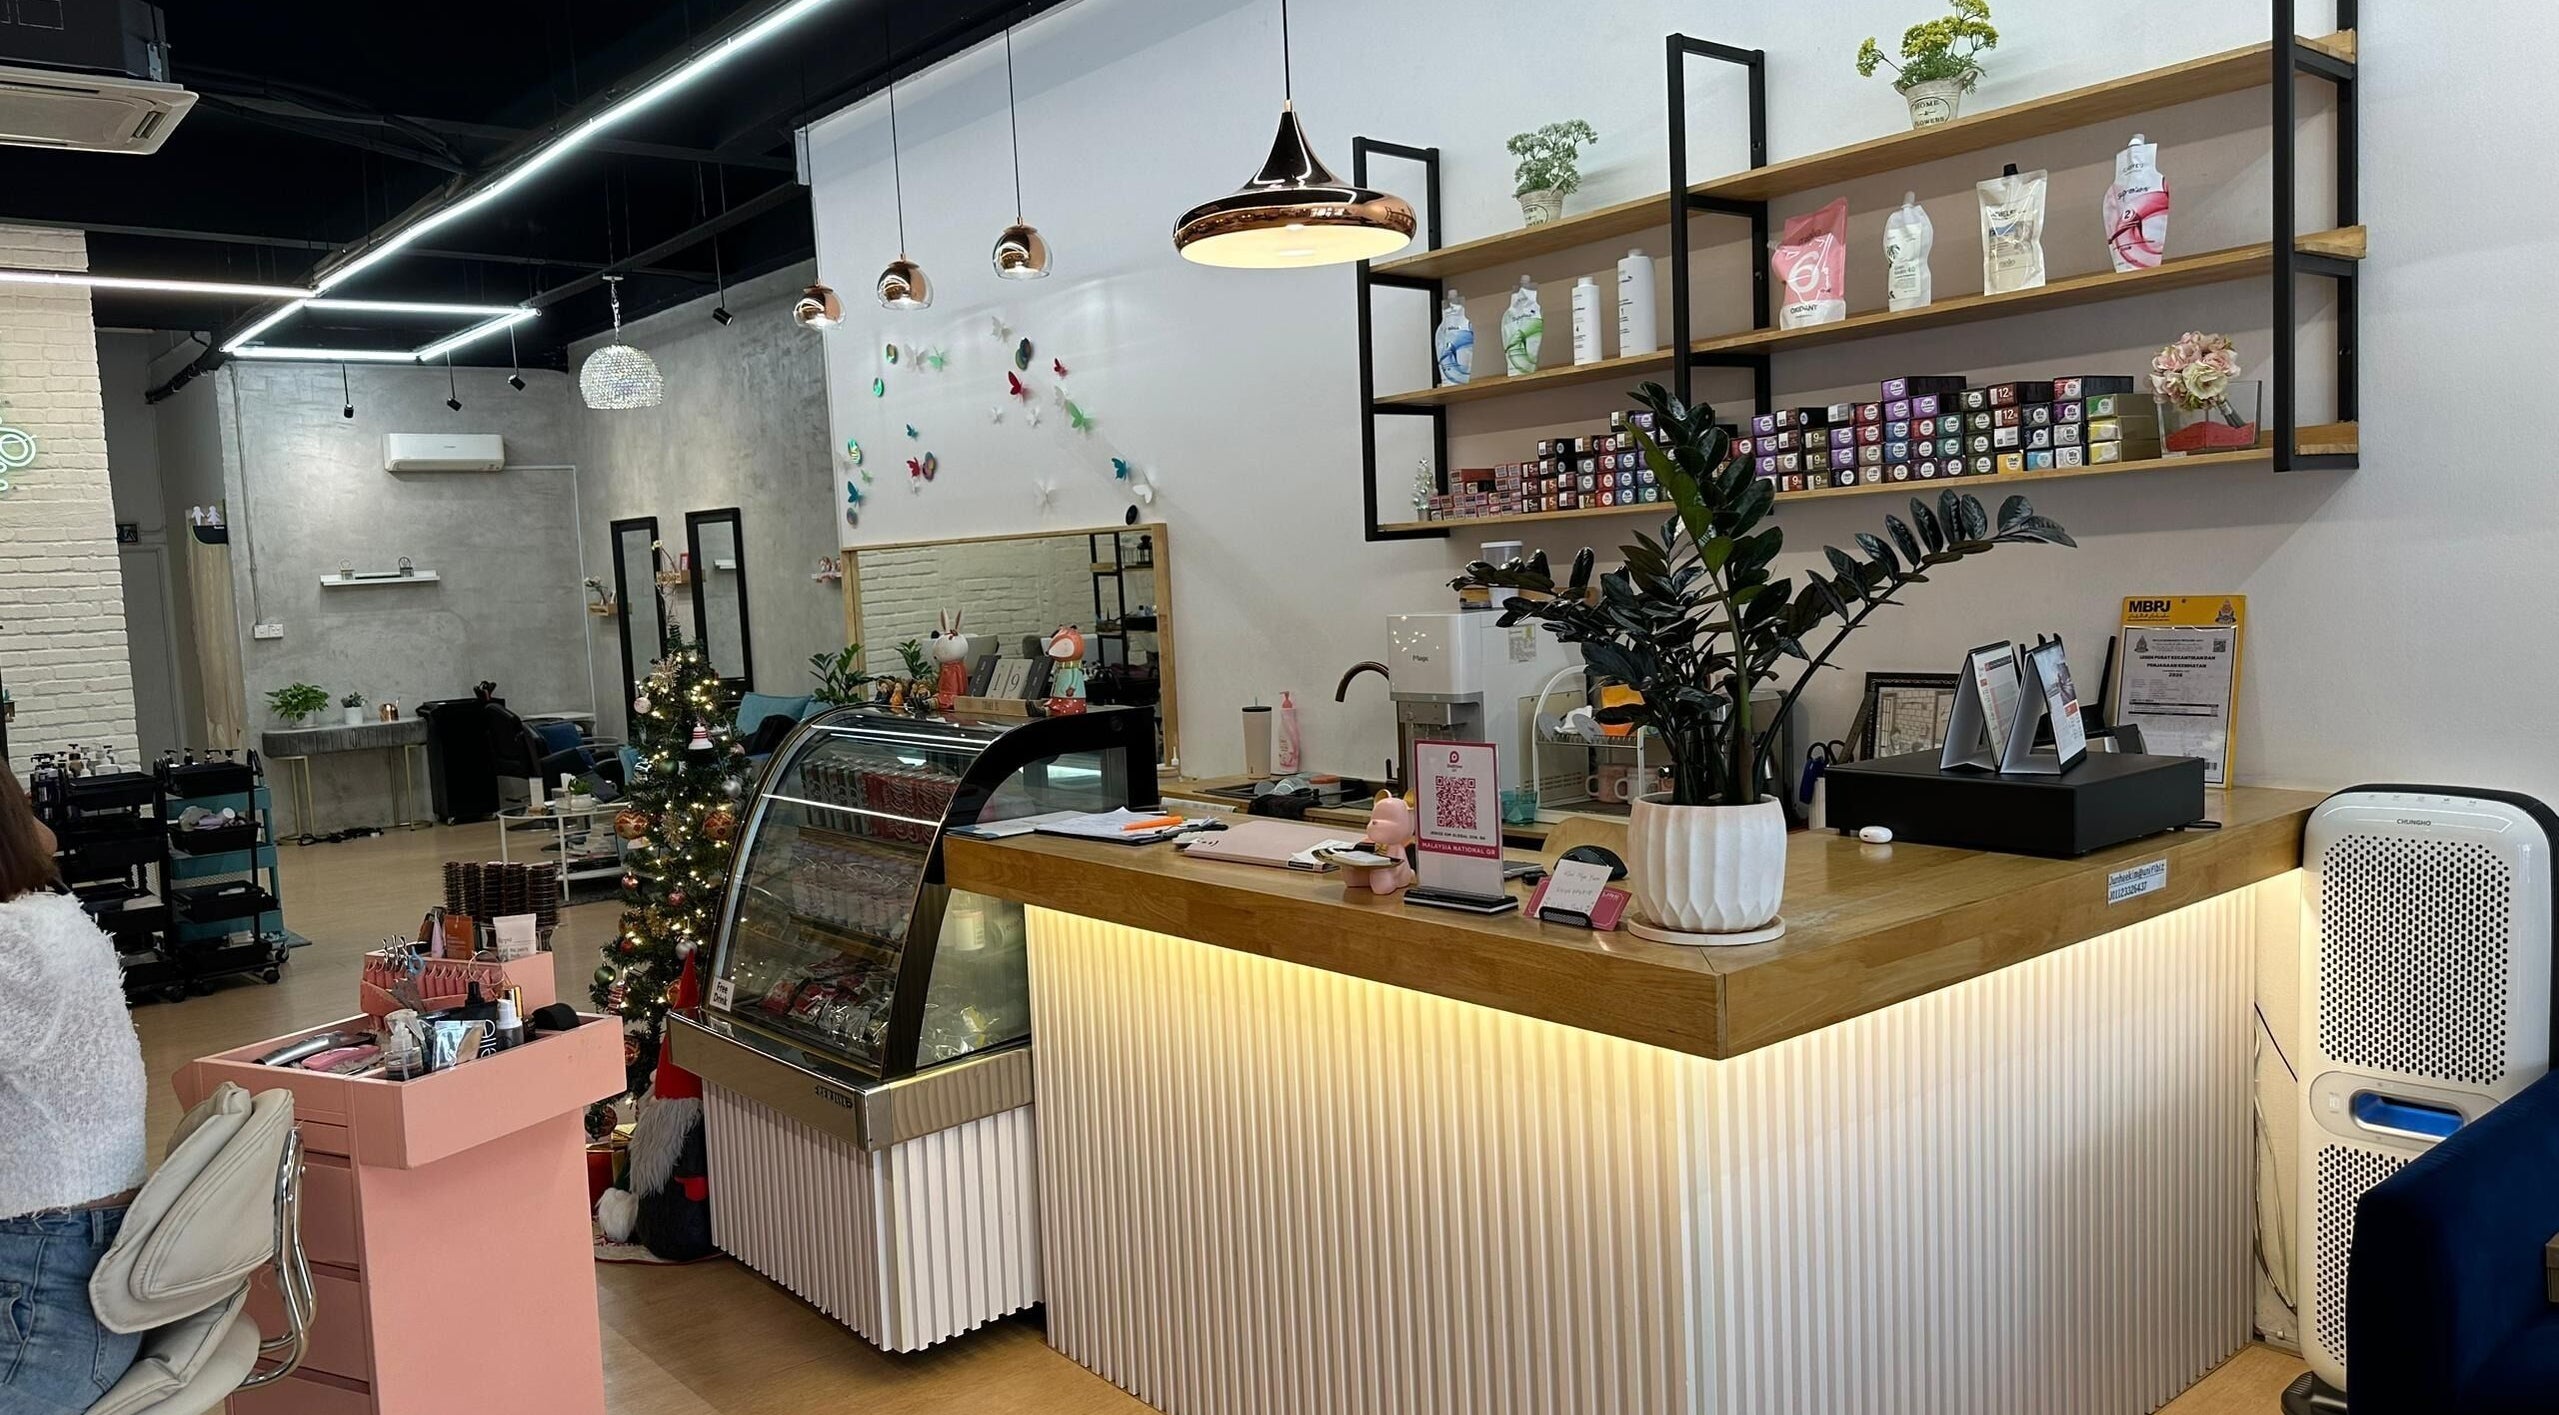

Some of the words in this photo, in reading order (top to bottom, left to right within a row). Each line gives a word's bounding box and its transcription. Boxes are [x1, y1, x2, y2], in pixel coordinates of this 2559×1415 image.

[1914, 100, 1940, 111] HOME
[1788, 251, 1819, 293] 6
[2129, 600, 2171, 612] MBPJ
[1421, 842, 1452, 851] MALAYSIA
[1452, 845, 1485, 855] NATIONAL
[716, 981, 729, 994] Free
[713, 993, 728, 1007] Drink
